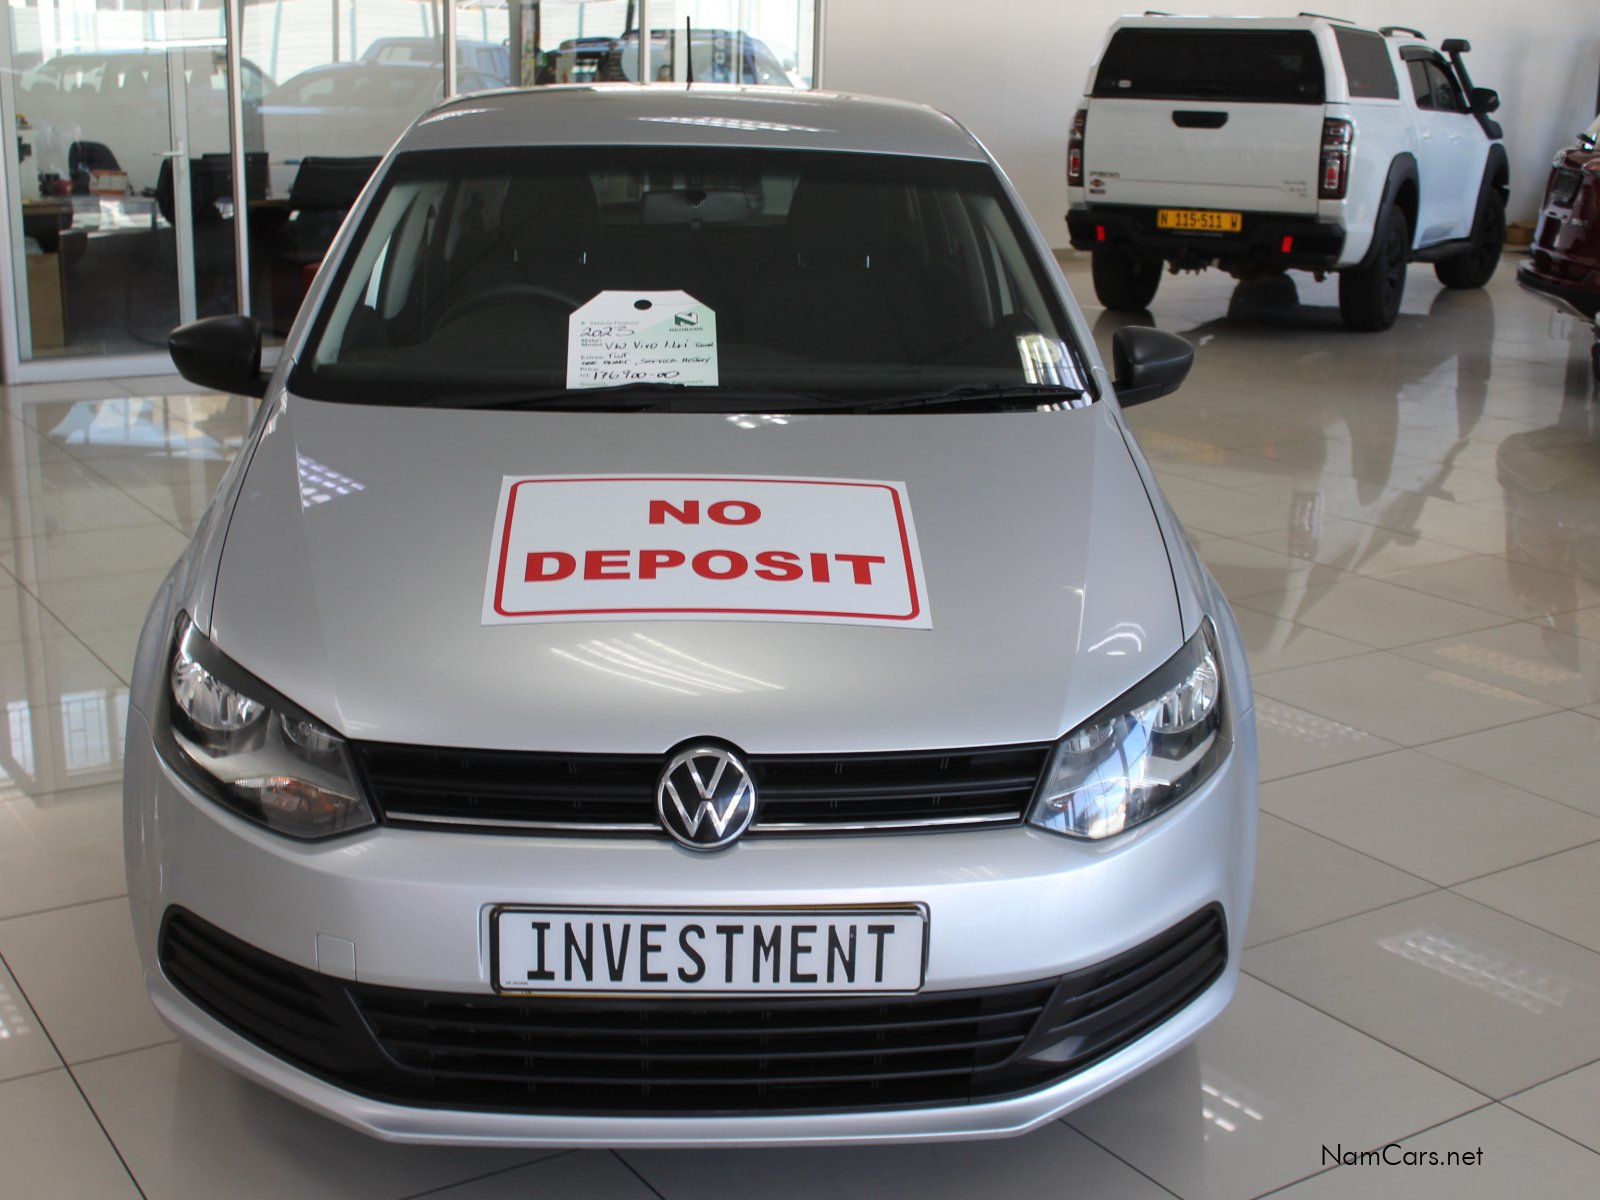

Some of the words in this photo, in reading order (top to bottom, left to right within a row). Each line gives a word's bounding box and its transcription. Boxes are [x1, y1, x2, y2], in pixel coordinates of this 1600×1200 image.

[1161, 212, 1168, 225] N
[1176, 212, 1222, 228] 115-511
[1231, 215, 1238, 229] W
[580, 325, 635, 338] 2023
[604, 342, 627, 351] VW
[649, 499, 762, 526] NO
[524, 549, 886, 585] DEPOSIT
[527, 921, 895, 983] INVESTMENT
